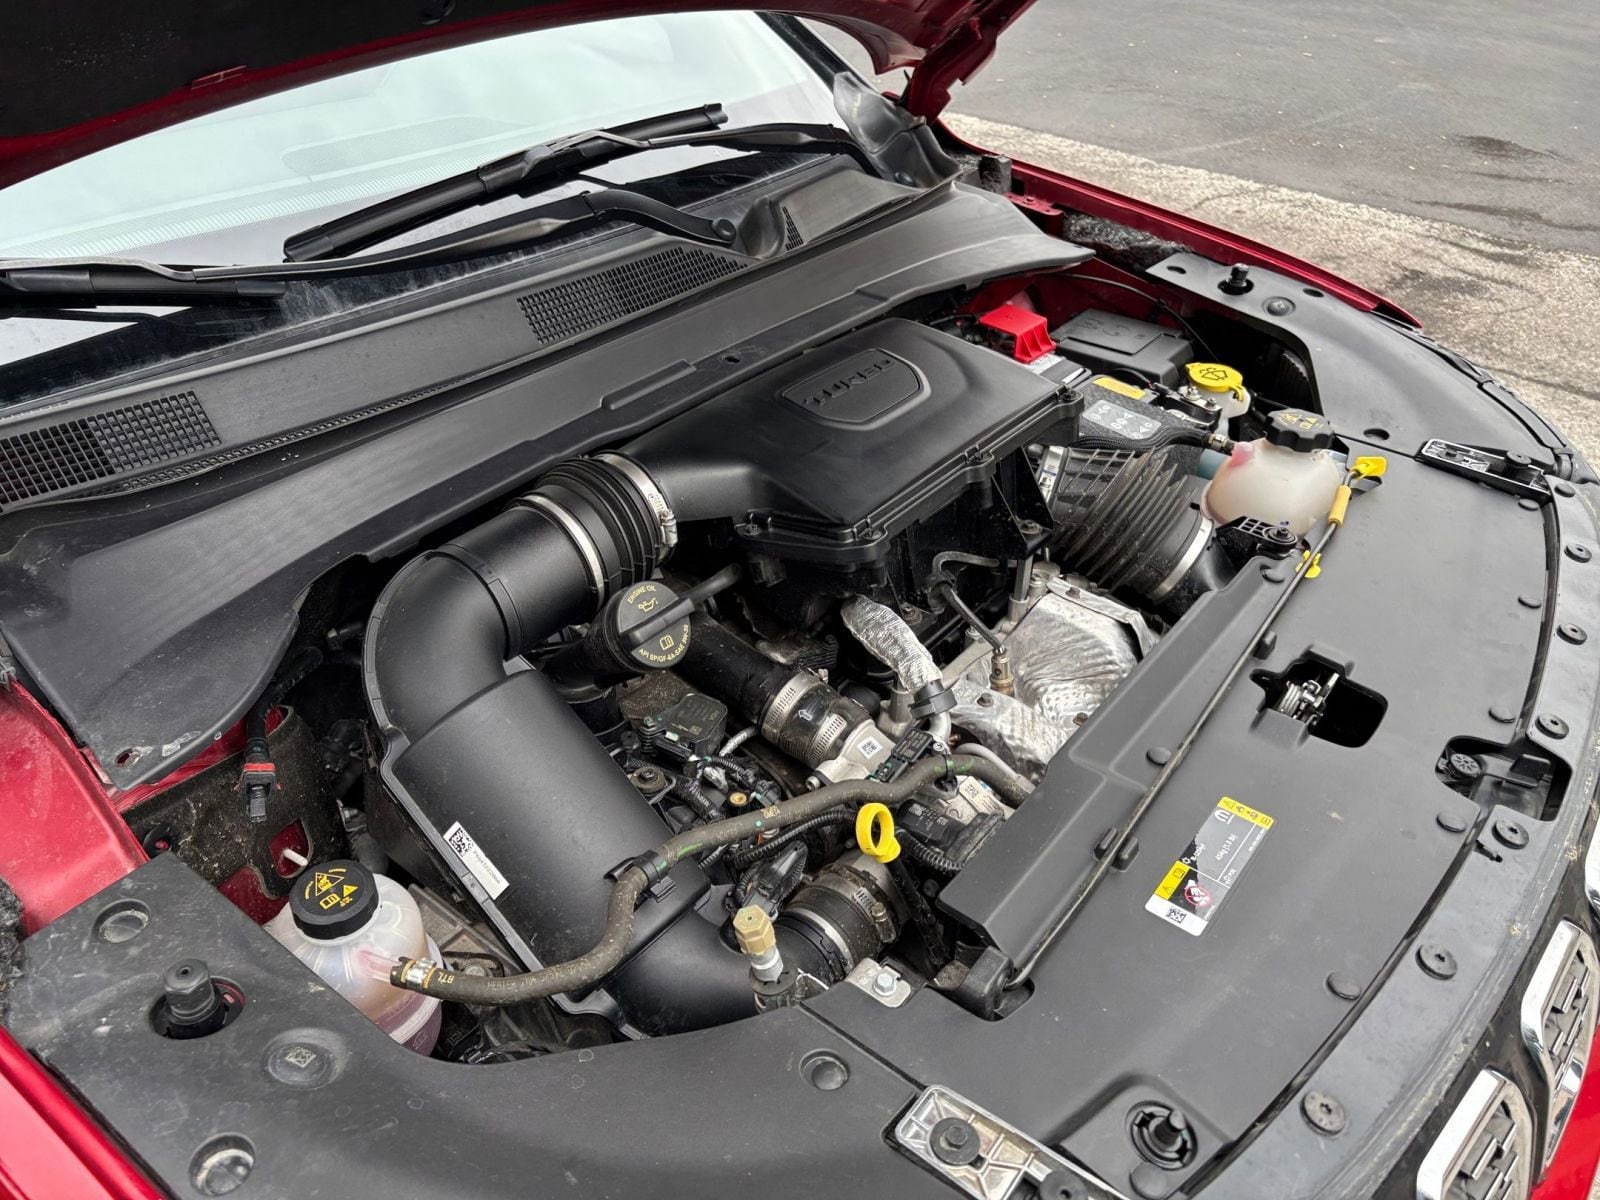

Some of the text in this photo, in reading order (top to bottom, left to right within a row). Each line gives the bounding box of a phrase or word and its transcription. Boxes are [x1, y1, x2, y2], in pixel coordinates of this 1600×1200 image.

[627, 584, 657, 604] ENGINE OIL
[638, 648, 650, 659] API
[674, 643, 686, 656] SAE
[437, 971, 454, 984] BTL
